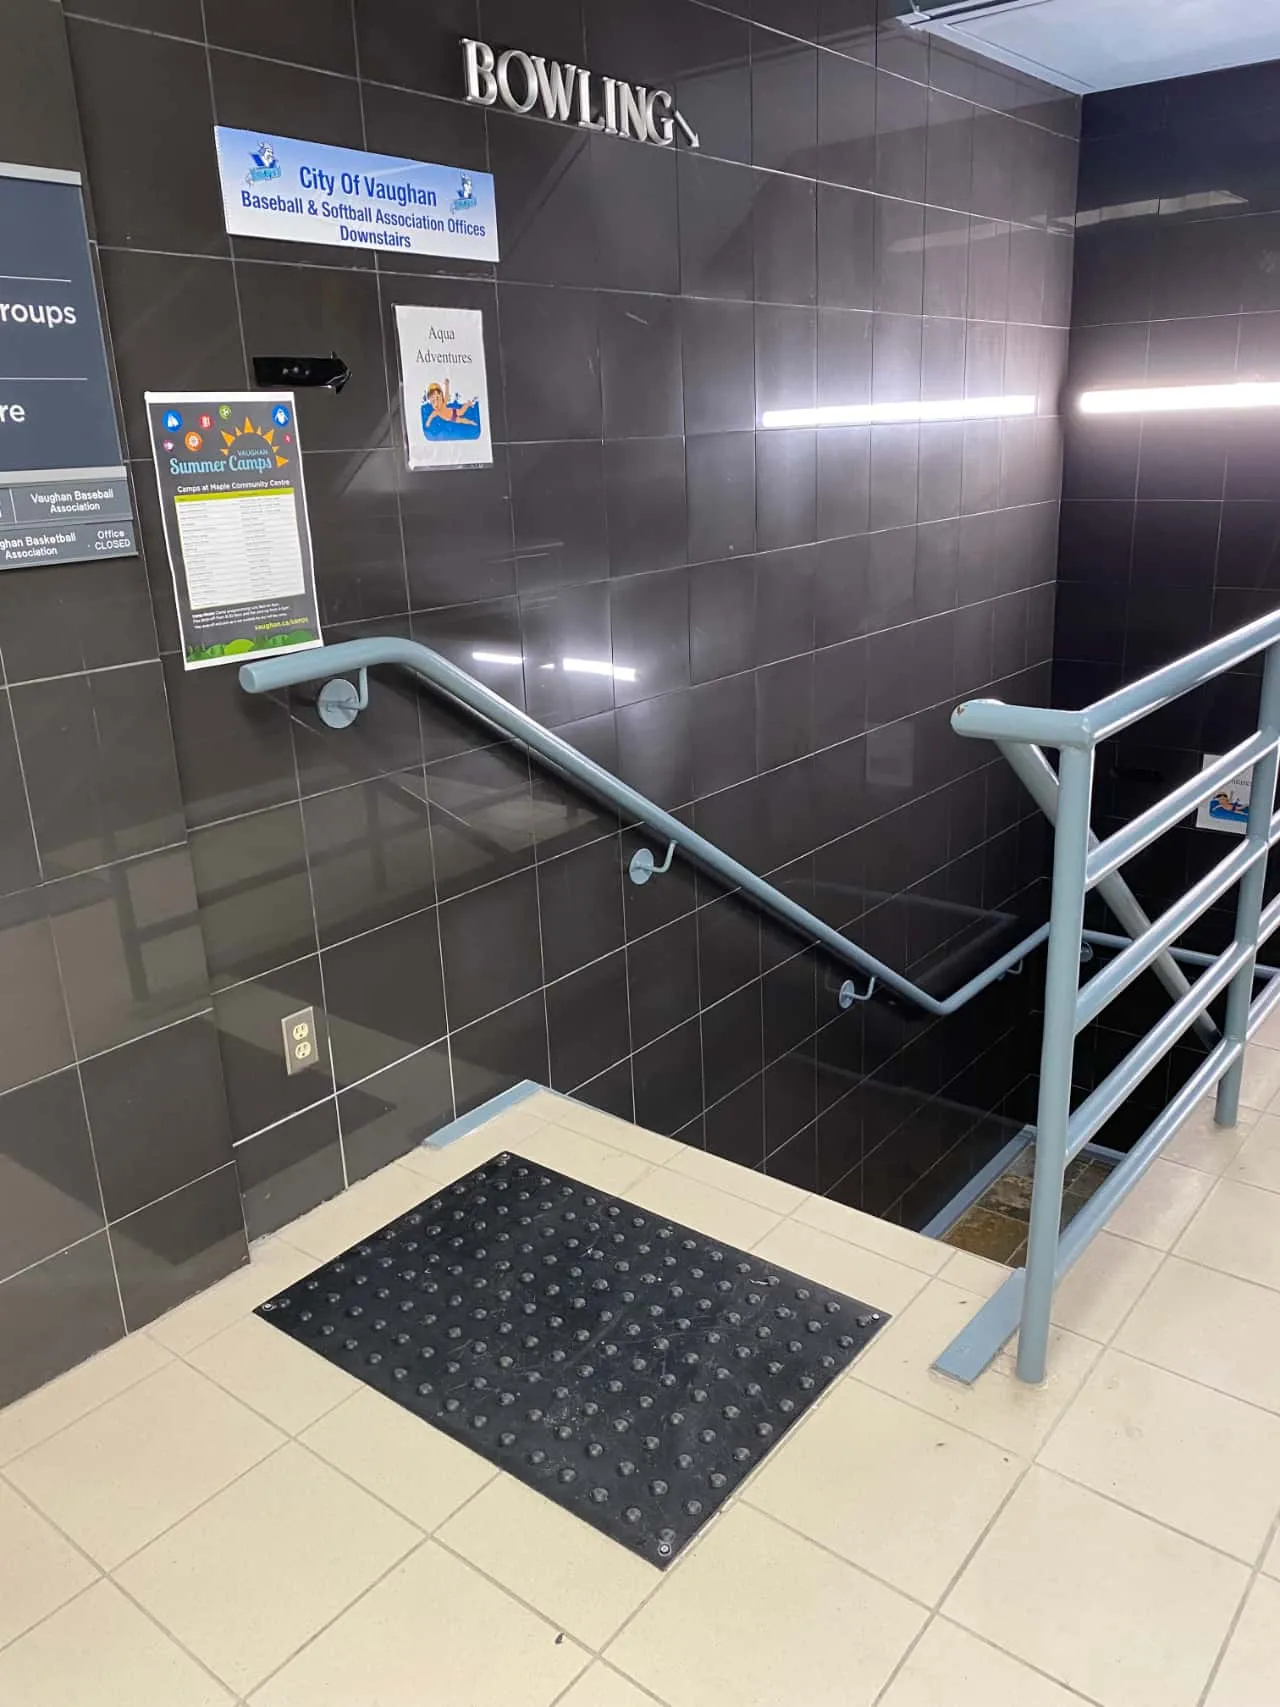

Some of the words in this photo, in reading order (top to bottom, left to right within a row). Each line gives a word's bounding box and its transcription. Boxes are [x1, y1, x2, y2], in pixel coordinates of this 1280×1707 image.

[459, 38, 674, 145] BOWLING
[300, 166, 335, 196] City
[341, 172, 360, 196] Of
[364, 176, 437, 207] Vaughan
[241, 190, 303, 214] Baseball
[308, 200, 318, 216] &
[322, 202, 372, 223] Softball
[376, 209, 444, 232] Association
[448, 218, 486, 237] Offices
[340, 225, 411, 248] Downstairs
[0, 303, 77, 328] roups
[428, 326, 455, 343] Aqua
[416, 349, 472, 364] Adventures
[169, 458, 227, 475] Summer
[229, 455, 272, 474] Camps
[177, 485, 201, 493] Camps
[210, 483, 230, 491] Maple
[232, 480, 268, 490] Community
[30, 493, 73, 504] Vaughan
[74, 488, 114, 501] Baseball
[50, 501, 101, 513] Association
[25, 532, 77, 546] Basketball
[97, 529, 125, 540] Office
[5, 546, 58, 560] Association
[95, 539, 131, 551] CLOSED
